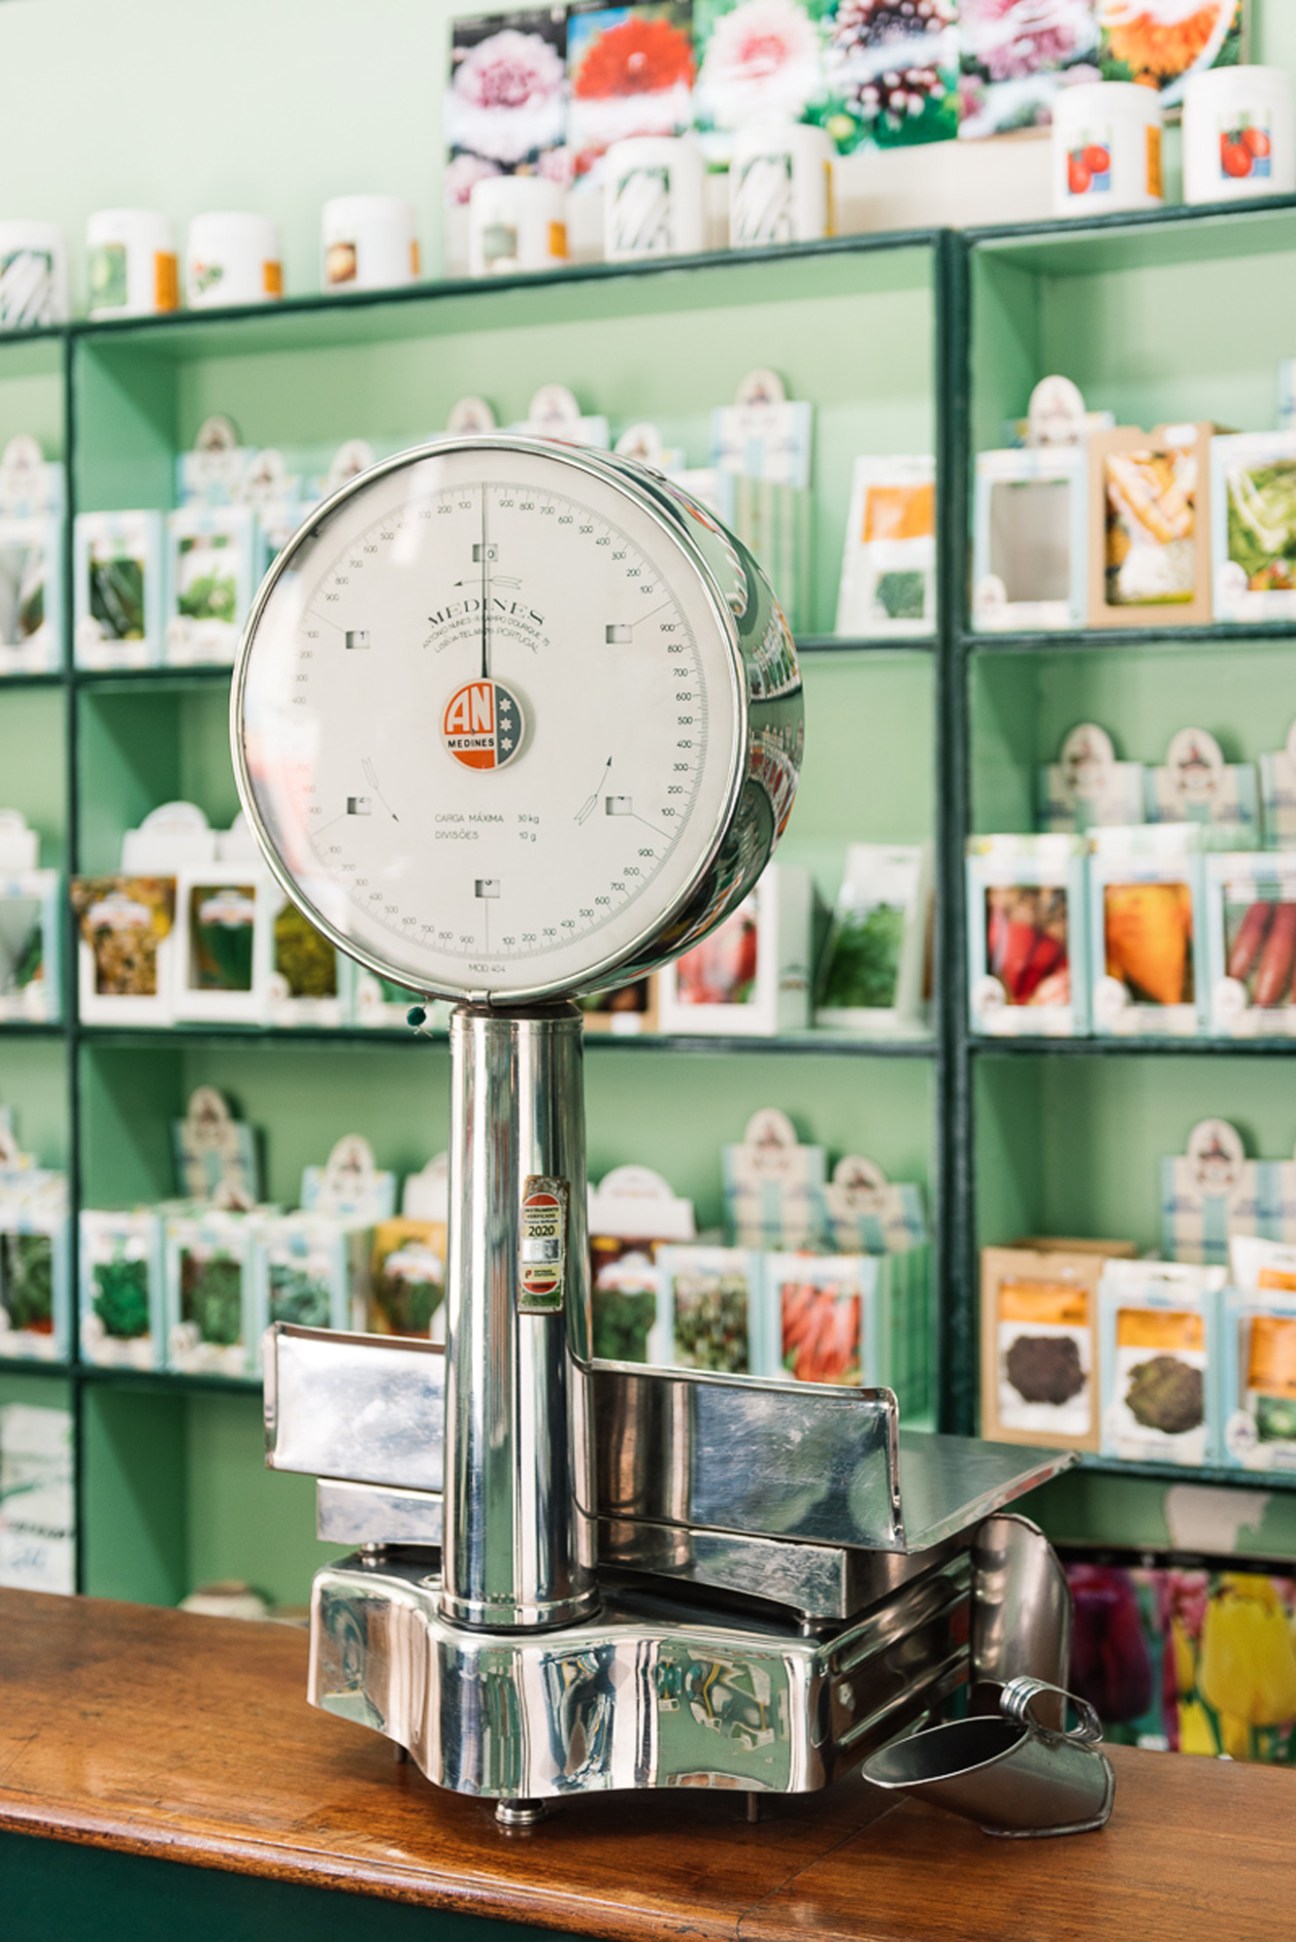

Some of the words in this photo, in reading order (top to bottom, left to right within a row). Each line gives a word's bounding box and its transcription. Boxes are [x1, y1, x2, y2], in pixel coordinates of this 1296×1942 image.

[458, 501, 471, 509] 100
[499, 499, 514, 508] 900
[519, 502, 534, 510] 800
[437, 505, 452, 514] 200
[540, 506, 555, 515] 700
[558, 516, 573, 524] 600
[579, 525, 594, 534] 500
[595, 537, 610, 546] 400
[488, 549, 495, 559] 0
[611, 551, 626, 560] 300
[626, 568, 641, 577] 200
[640, 585, 653, 594] 100
[428, 598, 545, 628] MEDINES
[660, 624, 675, 633] 900
[668, 644, 683, 653] 800
[673, 668, 688, 677] 700
[676, 692, 691, 701] 600
[447, 686, 491, 732] AN
[677, 716, 693, 725] 500
[448, 738, 495, 748] MEDINES
[677, 740, 692, 749] 400
[673, 763, 688, 772] 300
[668, 786, 683, 795] 200
[661, 808, 675, 816] 100
[435, 813, 465, 823] CARGA
[469, 811, 504, 823] MÁXIMA
[528, 814, 540, 825] kg
[435, 828, 479, 840] DIVISÕES
[638, 849, 654, 858] 900
[623, 867, 639, 876] 800
[611, 882, 625, 891] 700
[595, 896, 610, 905] 600
[579, 909, 594, 918] 500
[560, 920, 575, 928] 400
[542, 928, 557, 936] 300
[502, 936, 515, 945] 100
[522, 933, 536, 942] 200
[529, 1226, 554, 1237] 2020
